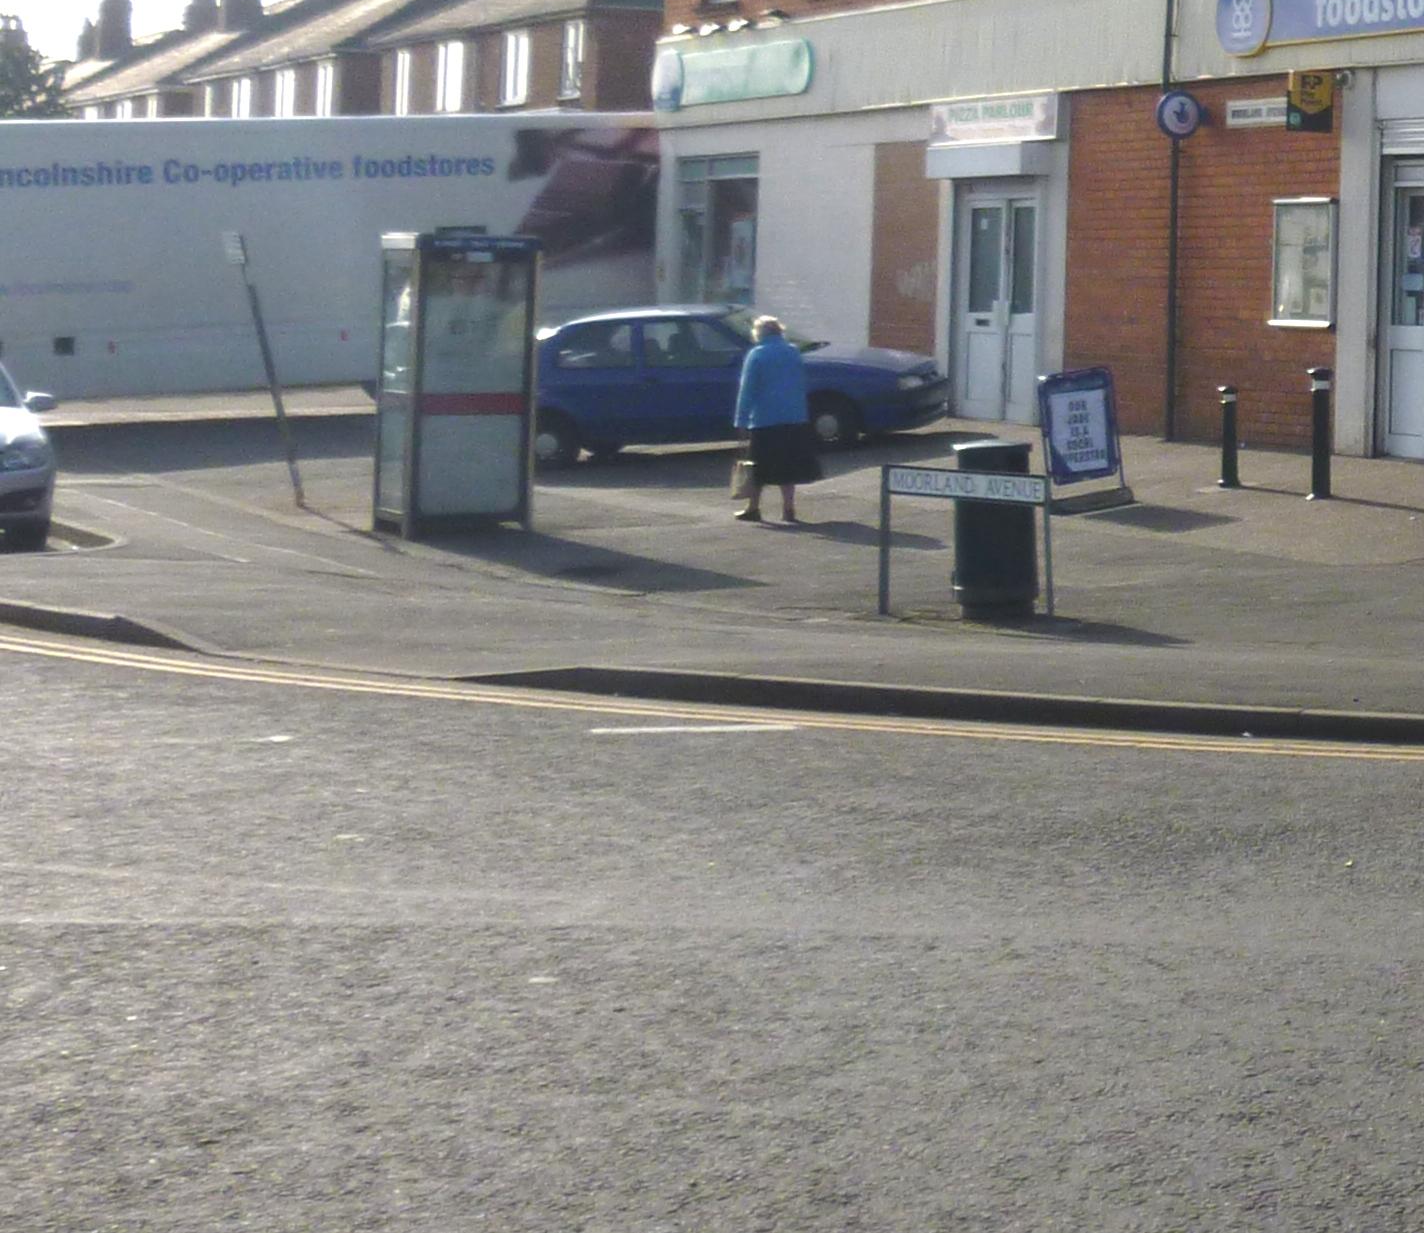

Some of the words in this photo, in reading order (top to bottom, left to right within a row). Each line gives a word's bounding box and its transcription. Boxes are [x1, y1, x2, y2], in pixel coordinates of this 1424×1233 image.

[163, 157, 344, 187] Co-operative
[353, 154, 495, 179] foodstores
[892, 471, 975, 494] MOORLAND
[985, 479, 1041, 500] AVENUE
